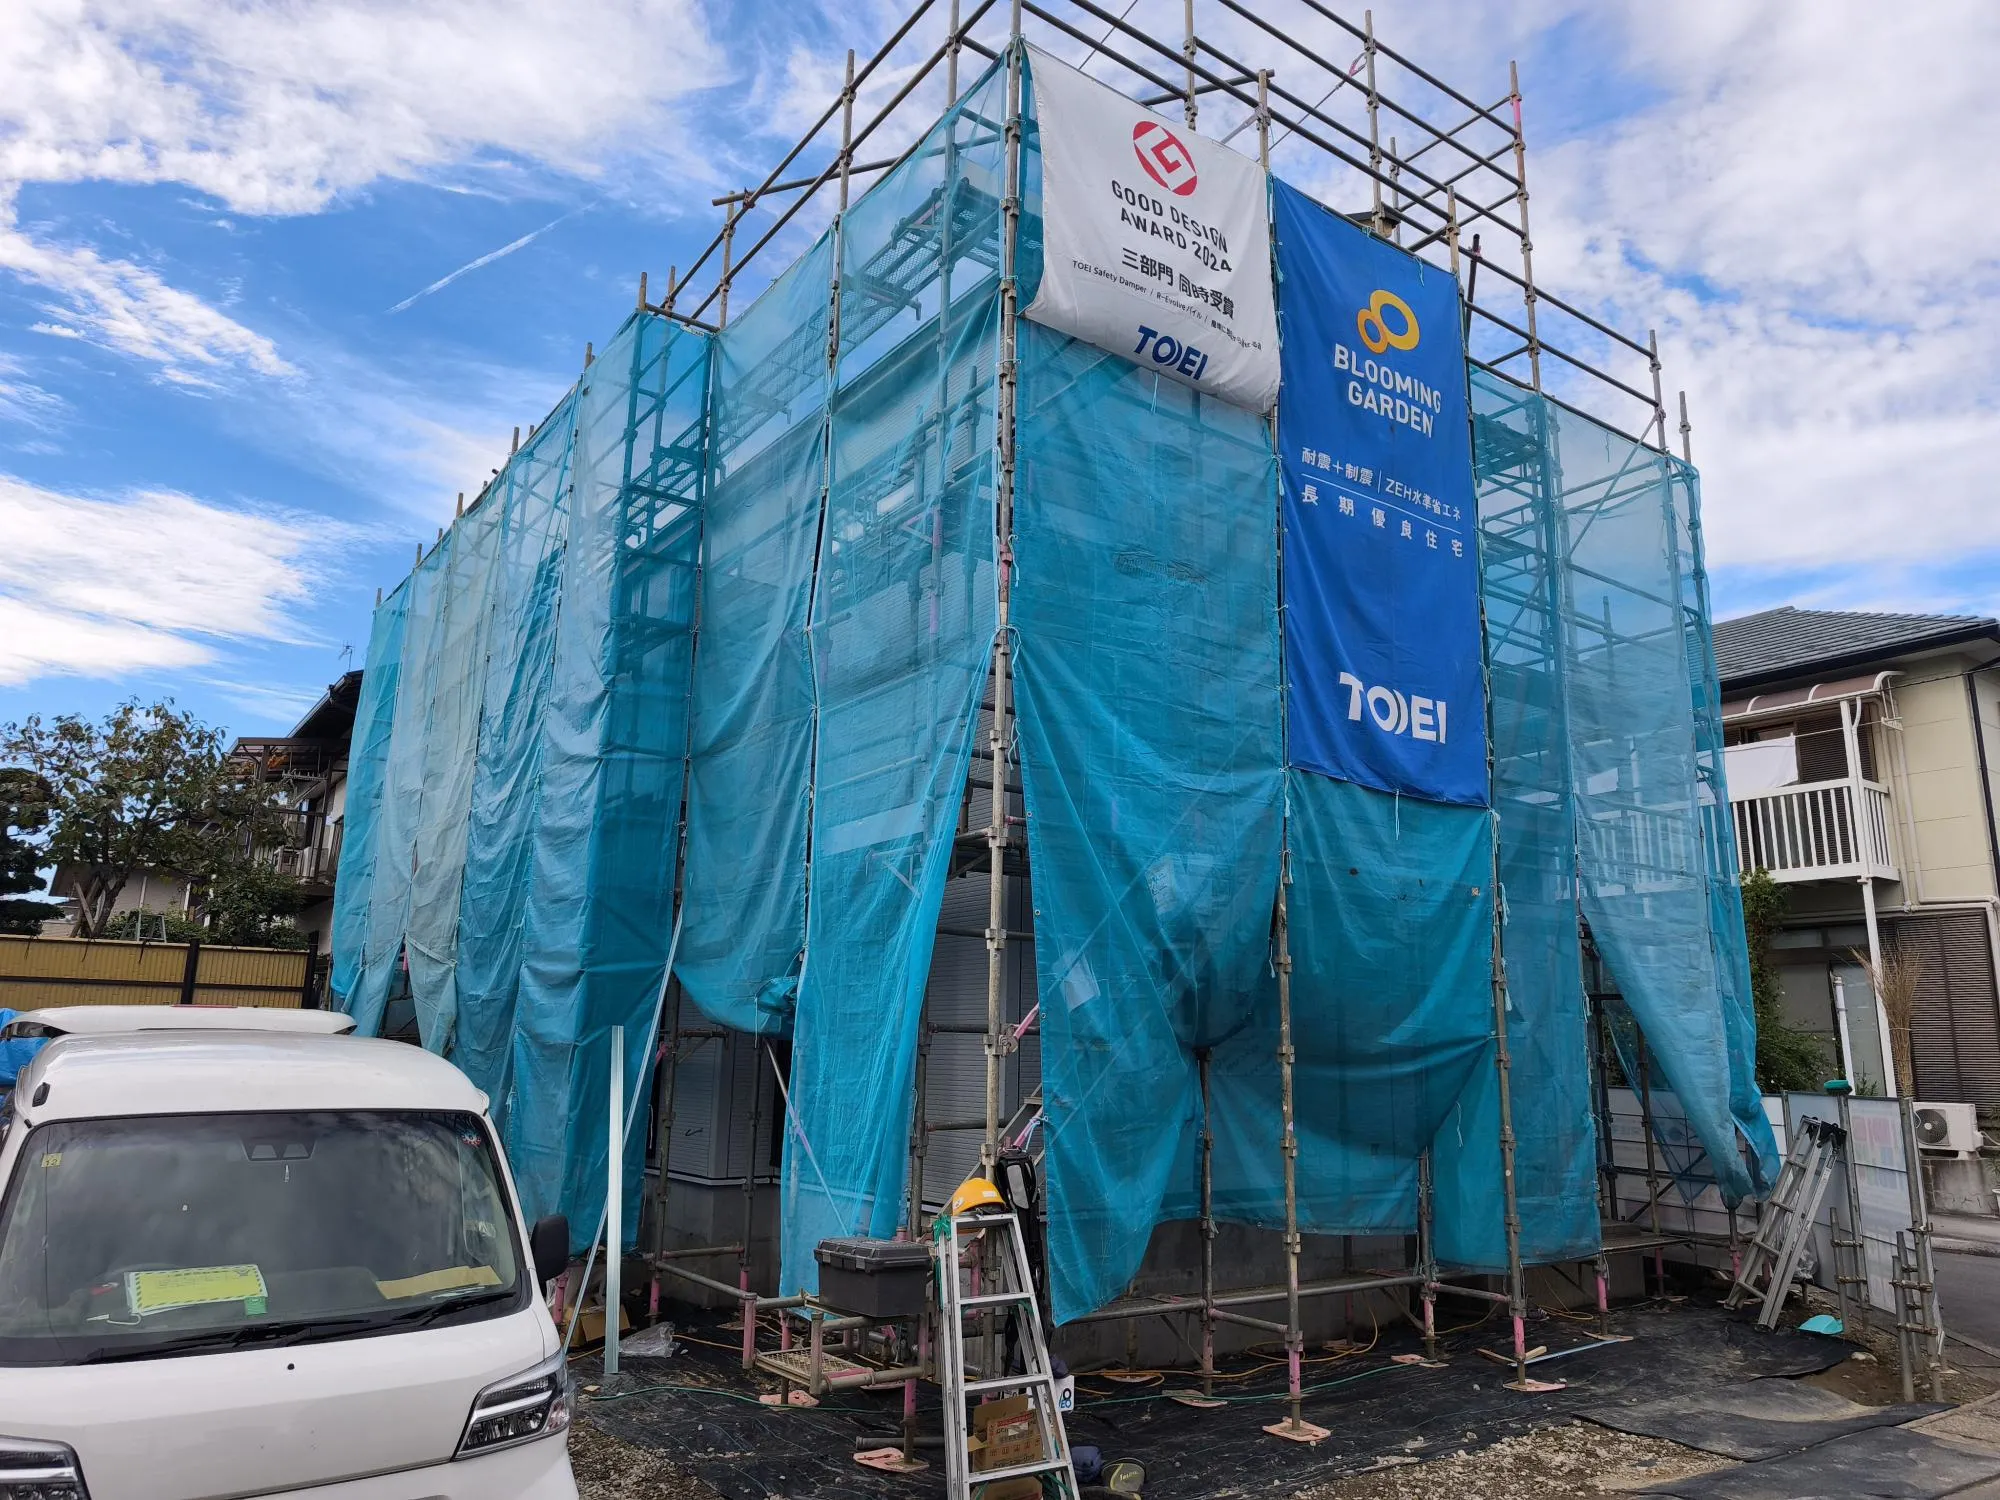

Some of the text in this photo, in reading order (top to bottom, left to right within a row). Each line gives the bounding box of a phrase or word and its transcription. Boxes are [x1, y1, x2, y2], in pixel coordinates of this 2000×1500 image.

[1111, 180, 1227, 253] GOOD DESIGN
[1121, 207, 1232, 272] AWARD 2024
[1072, 260, 1091, 272] TOEI
[1094, 267, 1117, 282] Safety
[1120, 276, 1146, 293] Damper
[1122, 247, 1233, 320] 三部門 同時受賞
[1134, 325, 1209, 380] TOEI
[1334, 343, 1441, 414] BLOOMING
[1348, 381, 1434, 438] GARDEN
[1385, 477, 1461, 521] ZEH水準省エネ
[1339, 671, 1447, 744] TOEI
